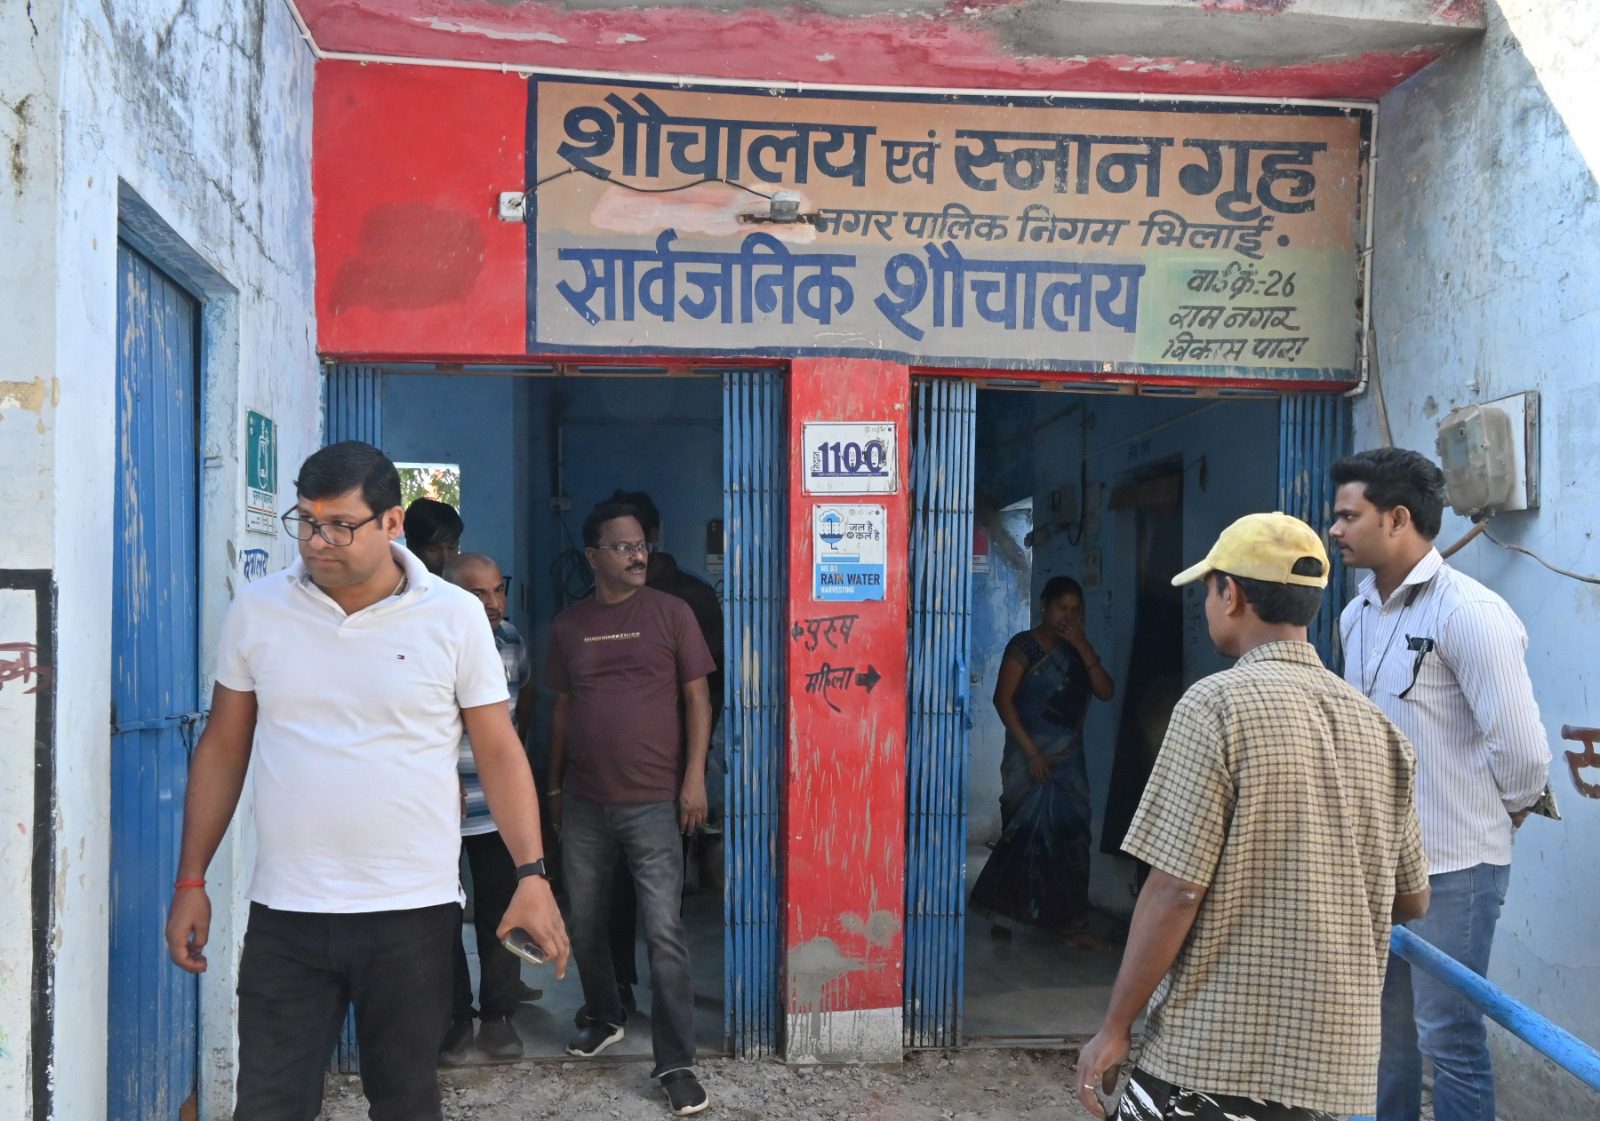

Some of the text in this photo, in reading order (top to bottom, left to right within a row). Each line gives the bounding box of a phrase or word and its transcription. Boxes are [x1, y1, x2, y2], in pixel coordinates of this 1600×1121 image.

[557, 92, 1327, 221] शौचालय एवं स्नान गृह
[815, 208, 899, 241] नगर
[903, 202, 1010, 241] पालिक
[1016, 204, 1130, 247] निगम
[556, 228, 1146, 342] सार्वजनिक शौचालय
[1168, 305, 1301, 331] राम नगर
[1161, 331, 1248, 361] विकास
[818, 441, 884, 473] 1100
[848, 523, 865, 532] जल
[820, 573, 880, 586] RAIN WATER
[804, 661, 855, 713] महिला
